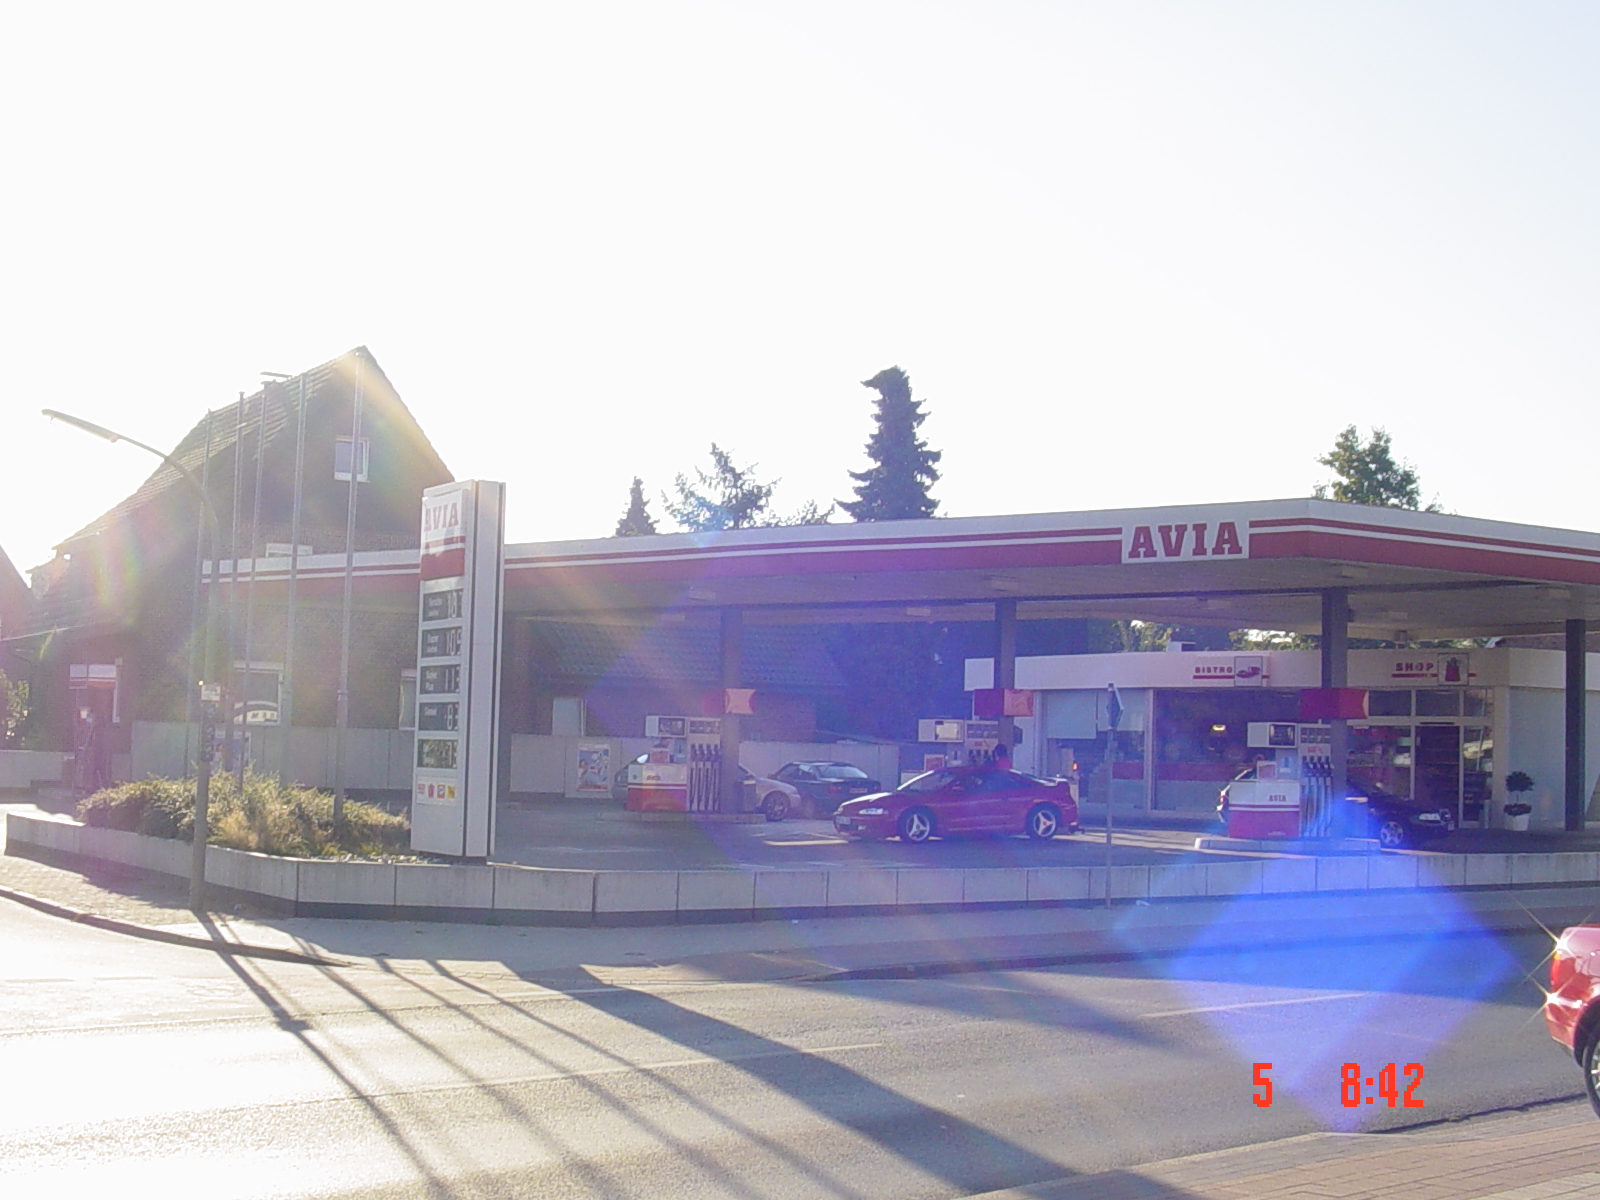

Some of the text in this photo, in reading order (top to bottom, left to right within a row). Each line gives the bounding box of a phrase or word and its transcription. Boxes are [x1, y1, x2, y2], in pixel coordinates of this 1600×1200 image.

[423, 502, 459, 532] AVIA
[1128, 521, 1243, 559] AVIA
[1195, 666, 1233, 674] BISTRO
[1395, 662, 1435, 672] SHOP
